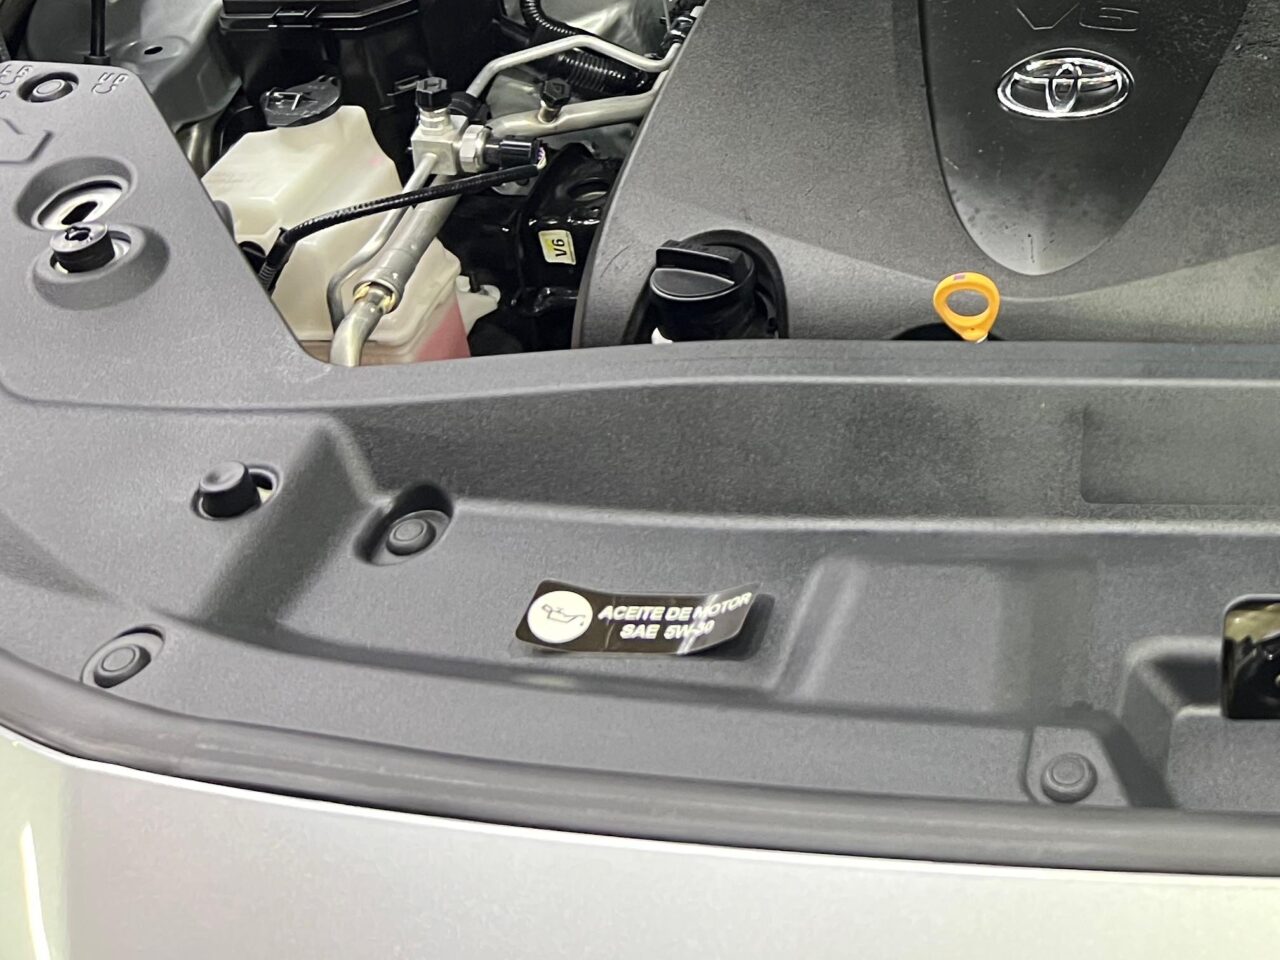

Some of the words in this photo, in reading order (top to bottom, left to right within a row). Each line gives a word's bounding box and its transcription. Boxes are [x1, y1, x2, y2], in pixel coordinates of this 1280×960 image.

[551, 238, 568, 258] V6
[597, 604, 666, 622] ACEITE
[664, 606, 694, 622] DE
[692, 591, 753, 620] MOTOR
[619, 623, 661, 640] SAE
[663, 619, 716, 640] 5W-30
